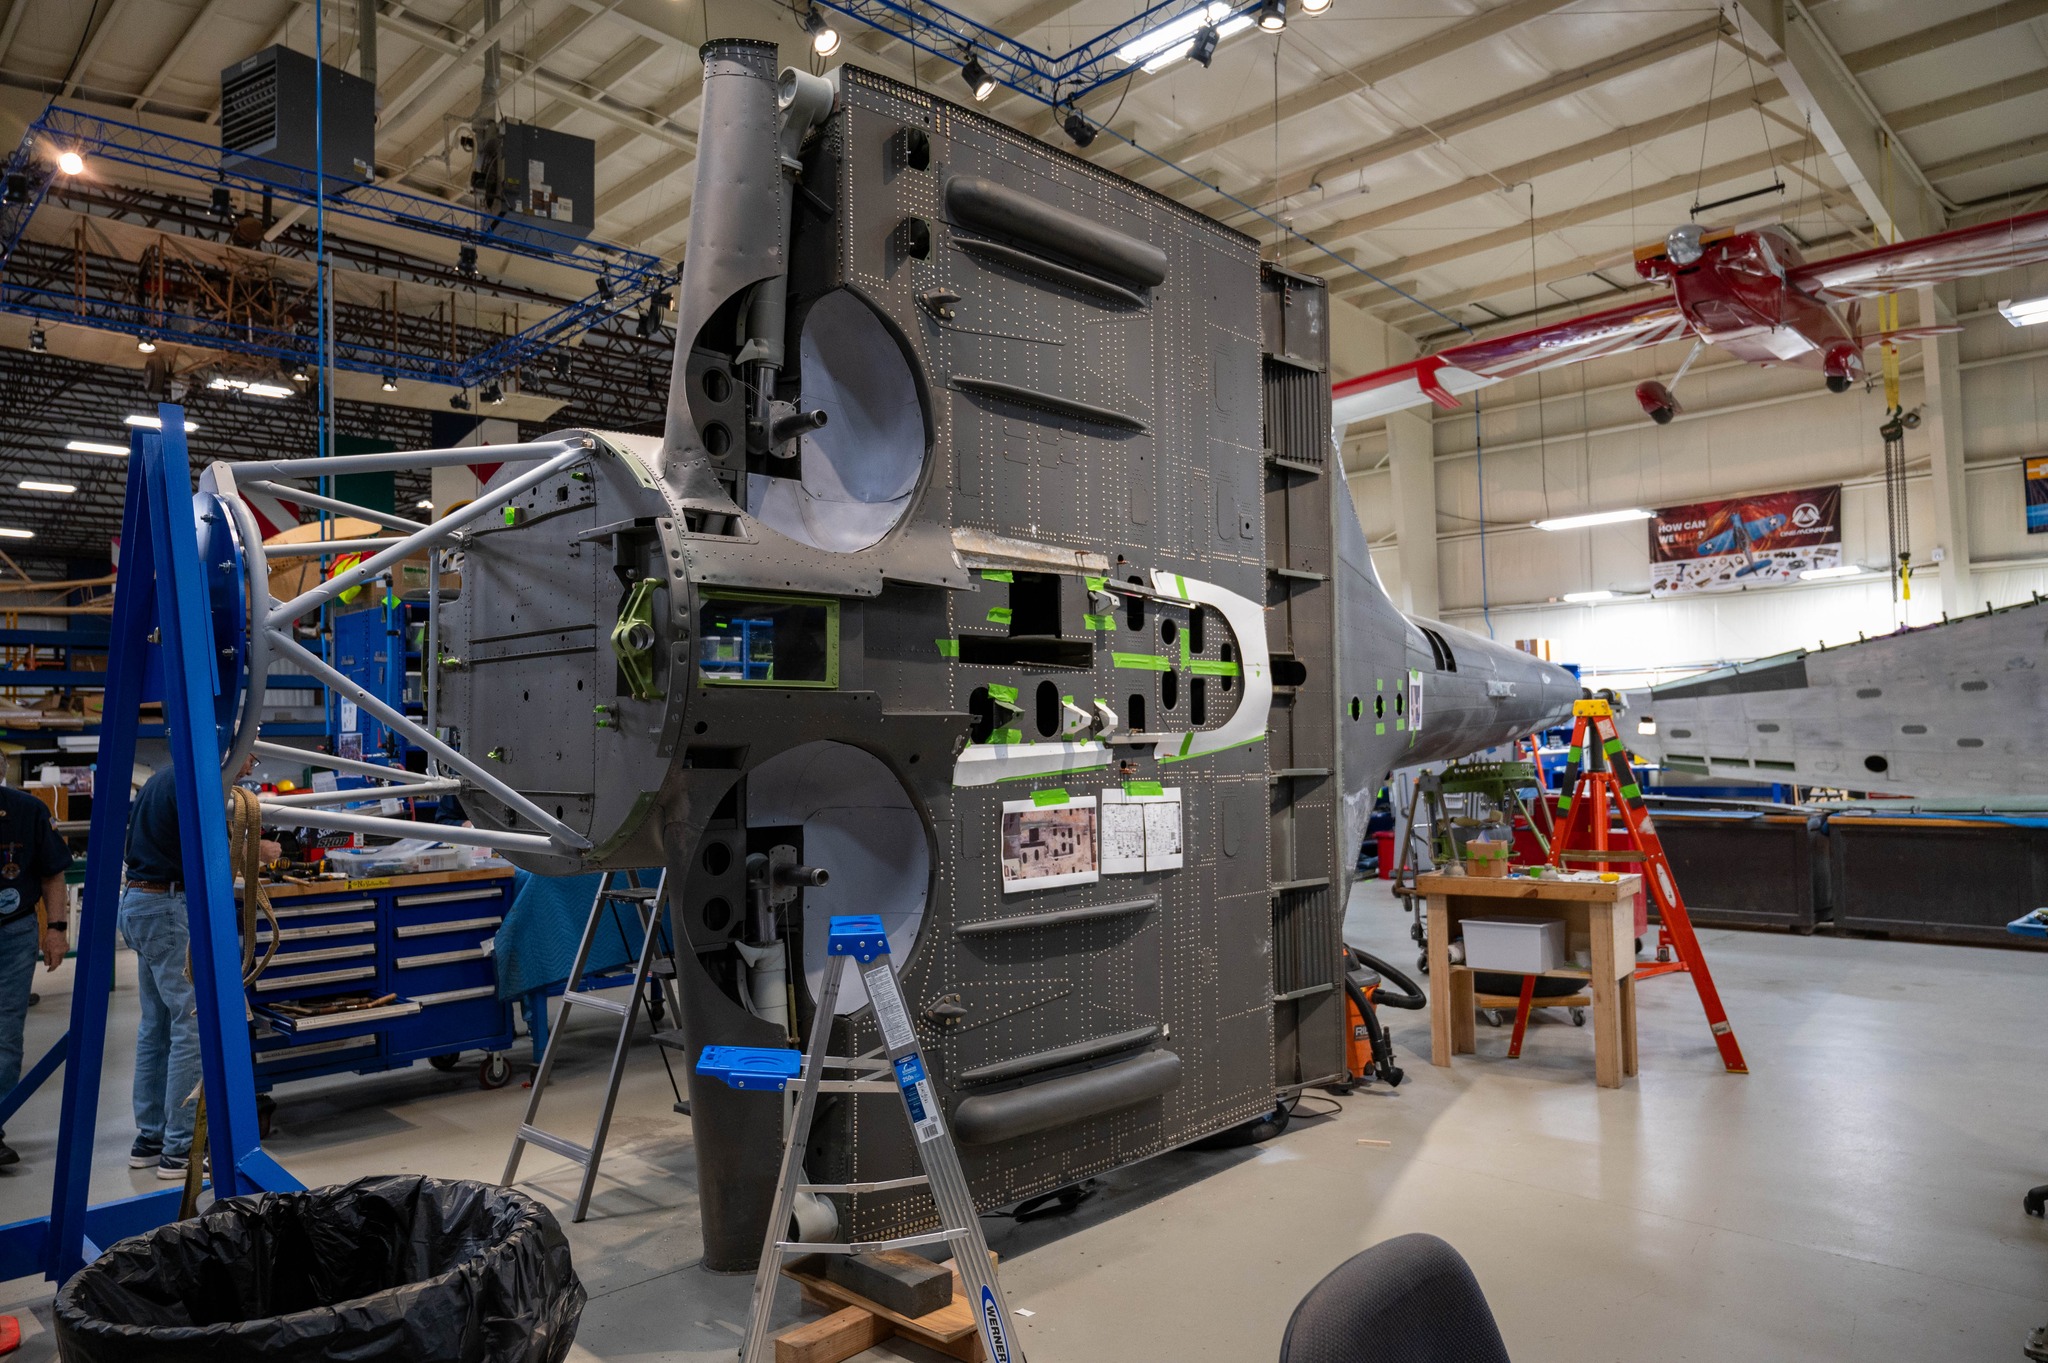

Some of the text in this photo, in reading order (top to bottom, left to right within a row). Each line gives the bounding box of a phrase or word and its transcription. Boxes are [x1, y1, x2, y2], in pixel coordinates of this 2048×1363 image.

[1658, 520, 1706, 533] HOW CAN
[1659, 535, 1674, 543] WE
[318, 836, 349, 847] SHOP
[986, 1305, 1007, 1362] WERNER
